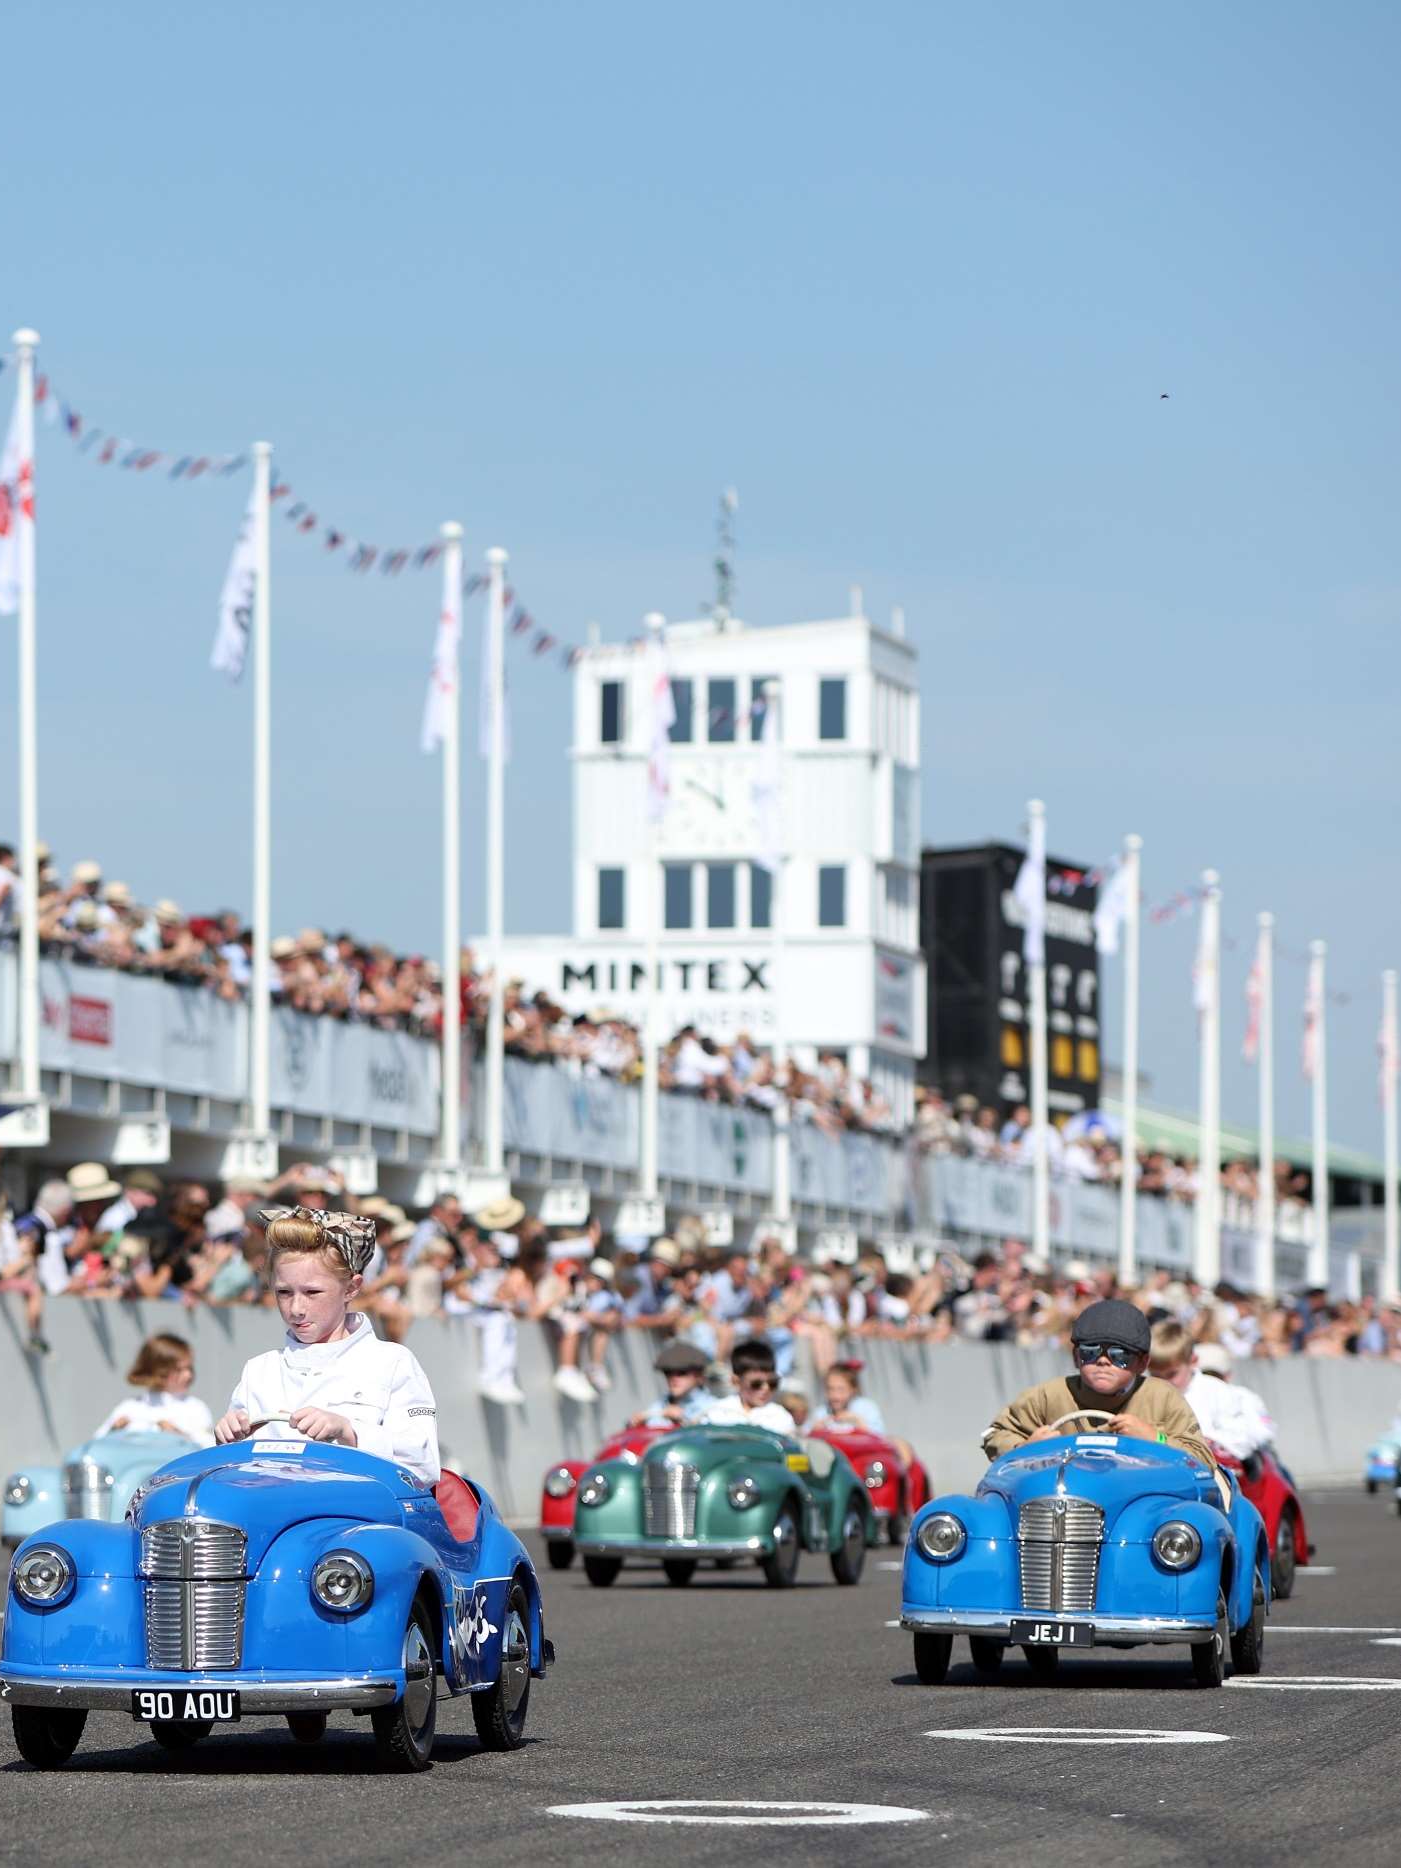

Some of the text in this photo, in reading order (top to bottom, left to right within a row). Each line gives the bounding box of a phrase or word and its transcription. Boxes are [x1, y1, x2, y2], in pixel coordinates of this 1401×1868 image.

[561, 959, 768, 992] MINTEX
[1028, 1624, 1063, 1642] JEJ
[139, 1692, 233, 1719] 90 AOU
